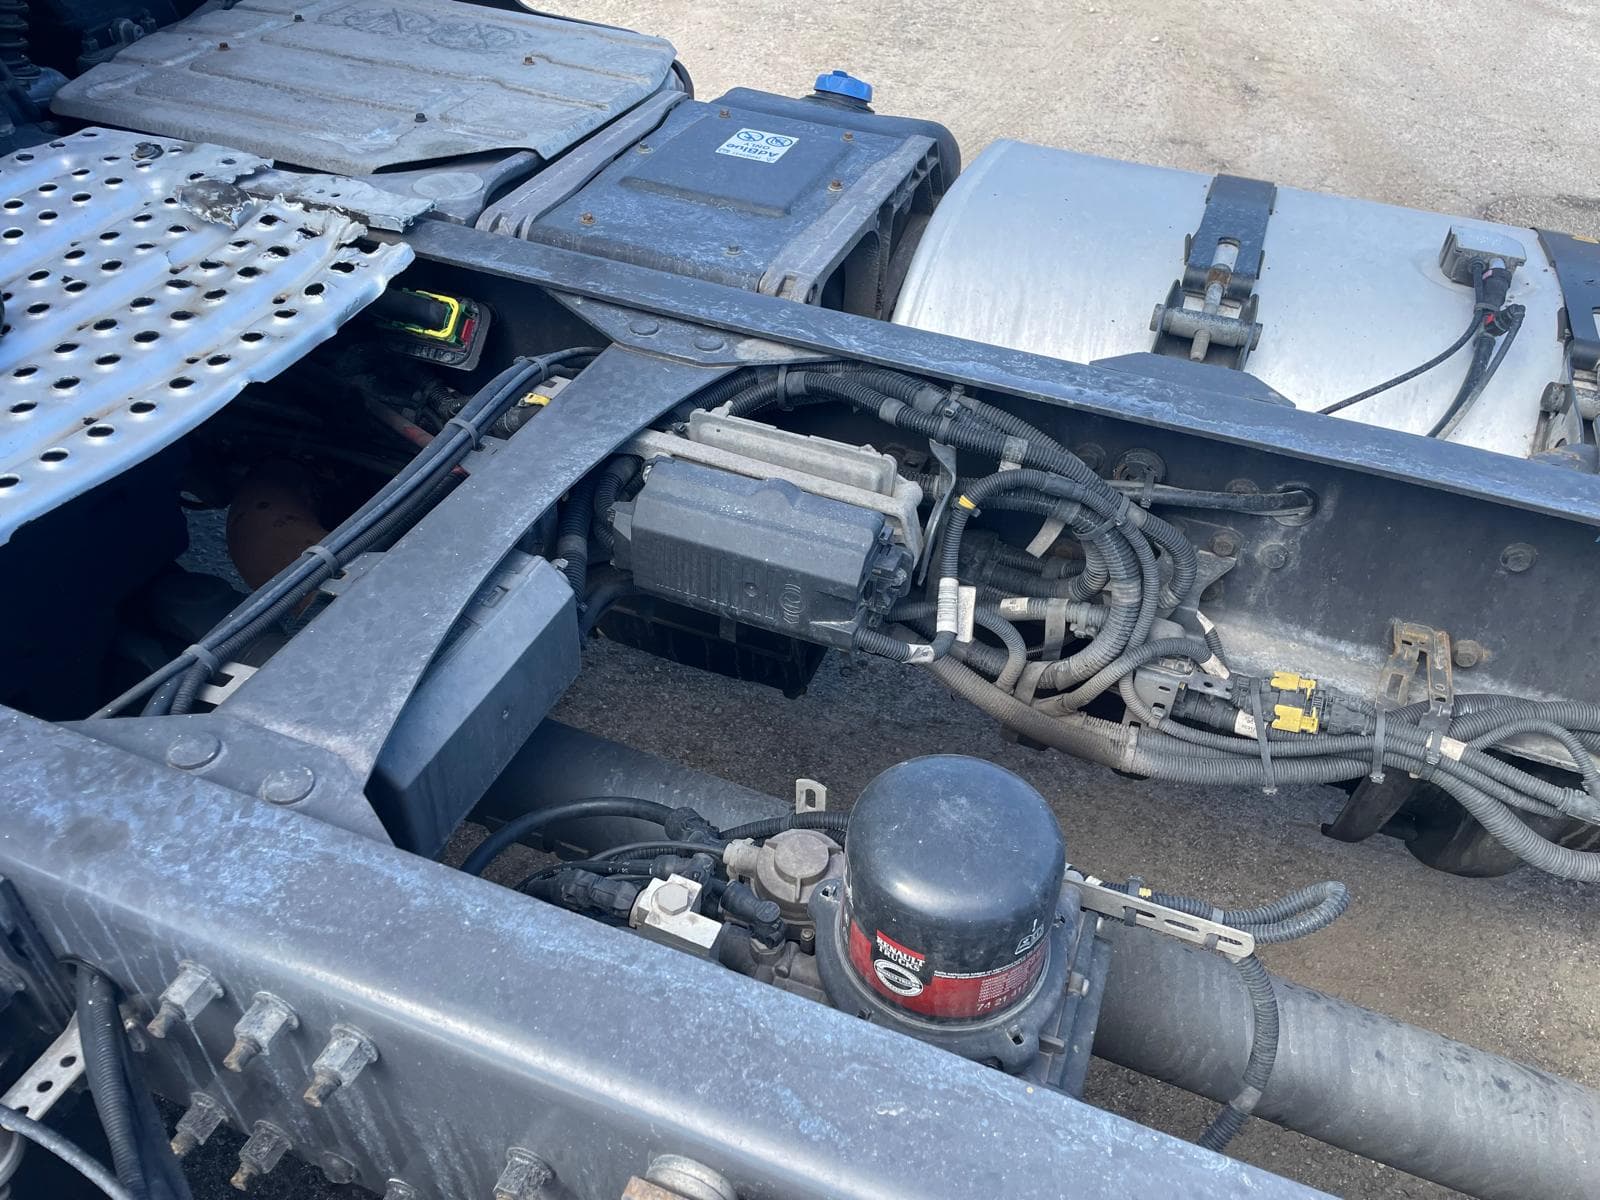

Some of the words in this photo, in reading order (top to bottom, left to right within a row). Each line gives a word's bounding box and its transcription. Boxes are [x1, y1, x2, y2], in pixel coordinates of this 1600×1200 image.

[726, 143, 780, 158] AdBlue
[743, 142, 770, 150] ONLY
[876, 935, 925, 967] RENAULT
[877, 942, 920, 972] TRUCKS
[977, 1001, 991, 1011] 74
[994, 996, 1007, 1006] 21
